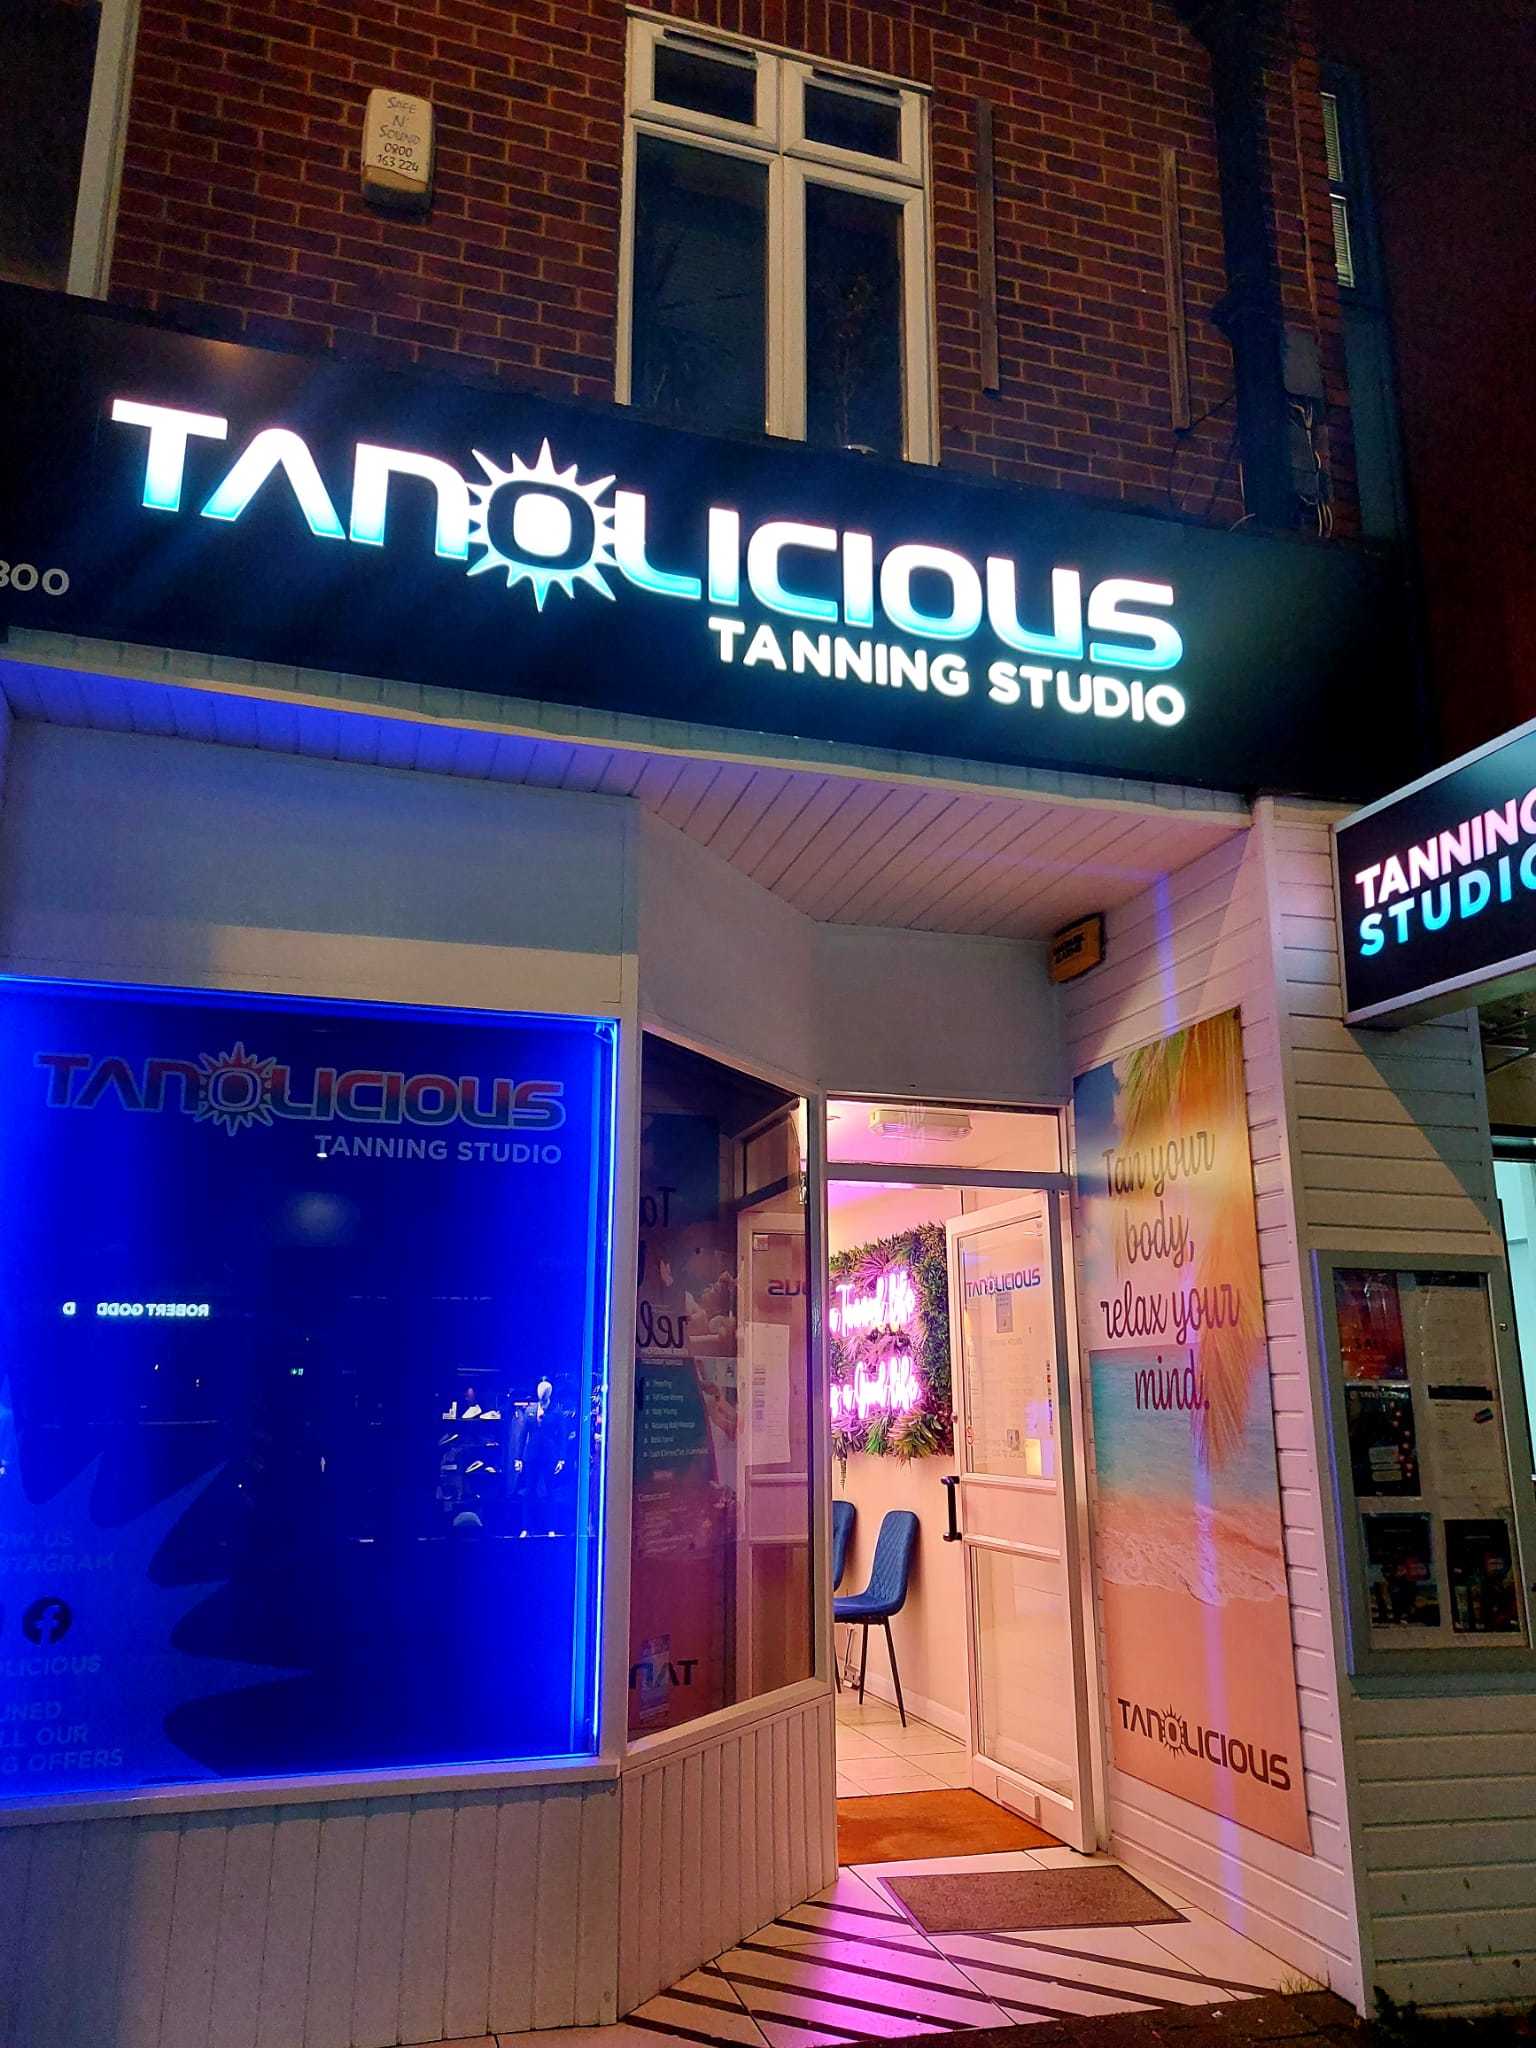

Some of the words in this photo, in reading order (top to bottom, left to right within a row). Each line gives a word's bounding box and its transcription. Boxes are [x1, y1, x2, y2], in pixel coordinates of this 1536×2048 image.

[379, 124, 421, 145] SOUND
[384, 142, 413, 158] 0800
[398, 159, 419, 173] 224
[111, 399, 1184, 672] TANOLICIOUS
[708, 616, 970, 698] TANNING
[987, 661, 1187, 728] STUDIO
[35, 1048, 567, 1132] TANOLICIOUS
[315, 1135, 448, 1161] TANNING
[458, 1141, 563, 1165] STUDIO
[1102, 1148, 1148, 1198] Tan
[1151, 1131, 1216, 1198] your
[1125, 1200, 1195, 1269] body,
[966, 1268, 1042, 1298] TANOLICIOUS
[1100, 1280, 1168, 1339] relax
[1171, 1284, 1241, 1346] your
[0, 1654, 103, 1678] LICIOUS
[36, 1725, 90, 1746] OUR
[1117, 1697, 1292, 1792] TANOLICIOUS
[28, 1747, 124, 1773] OFFERS
